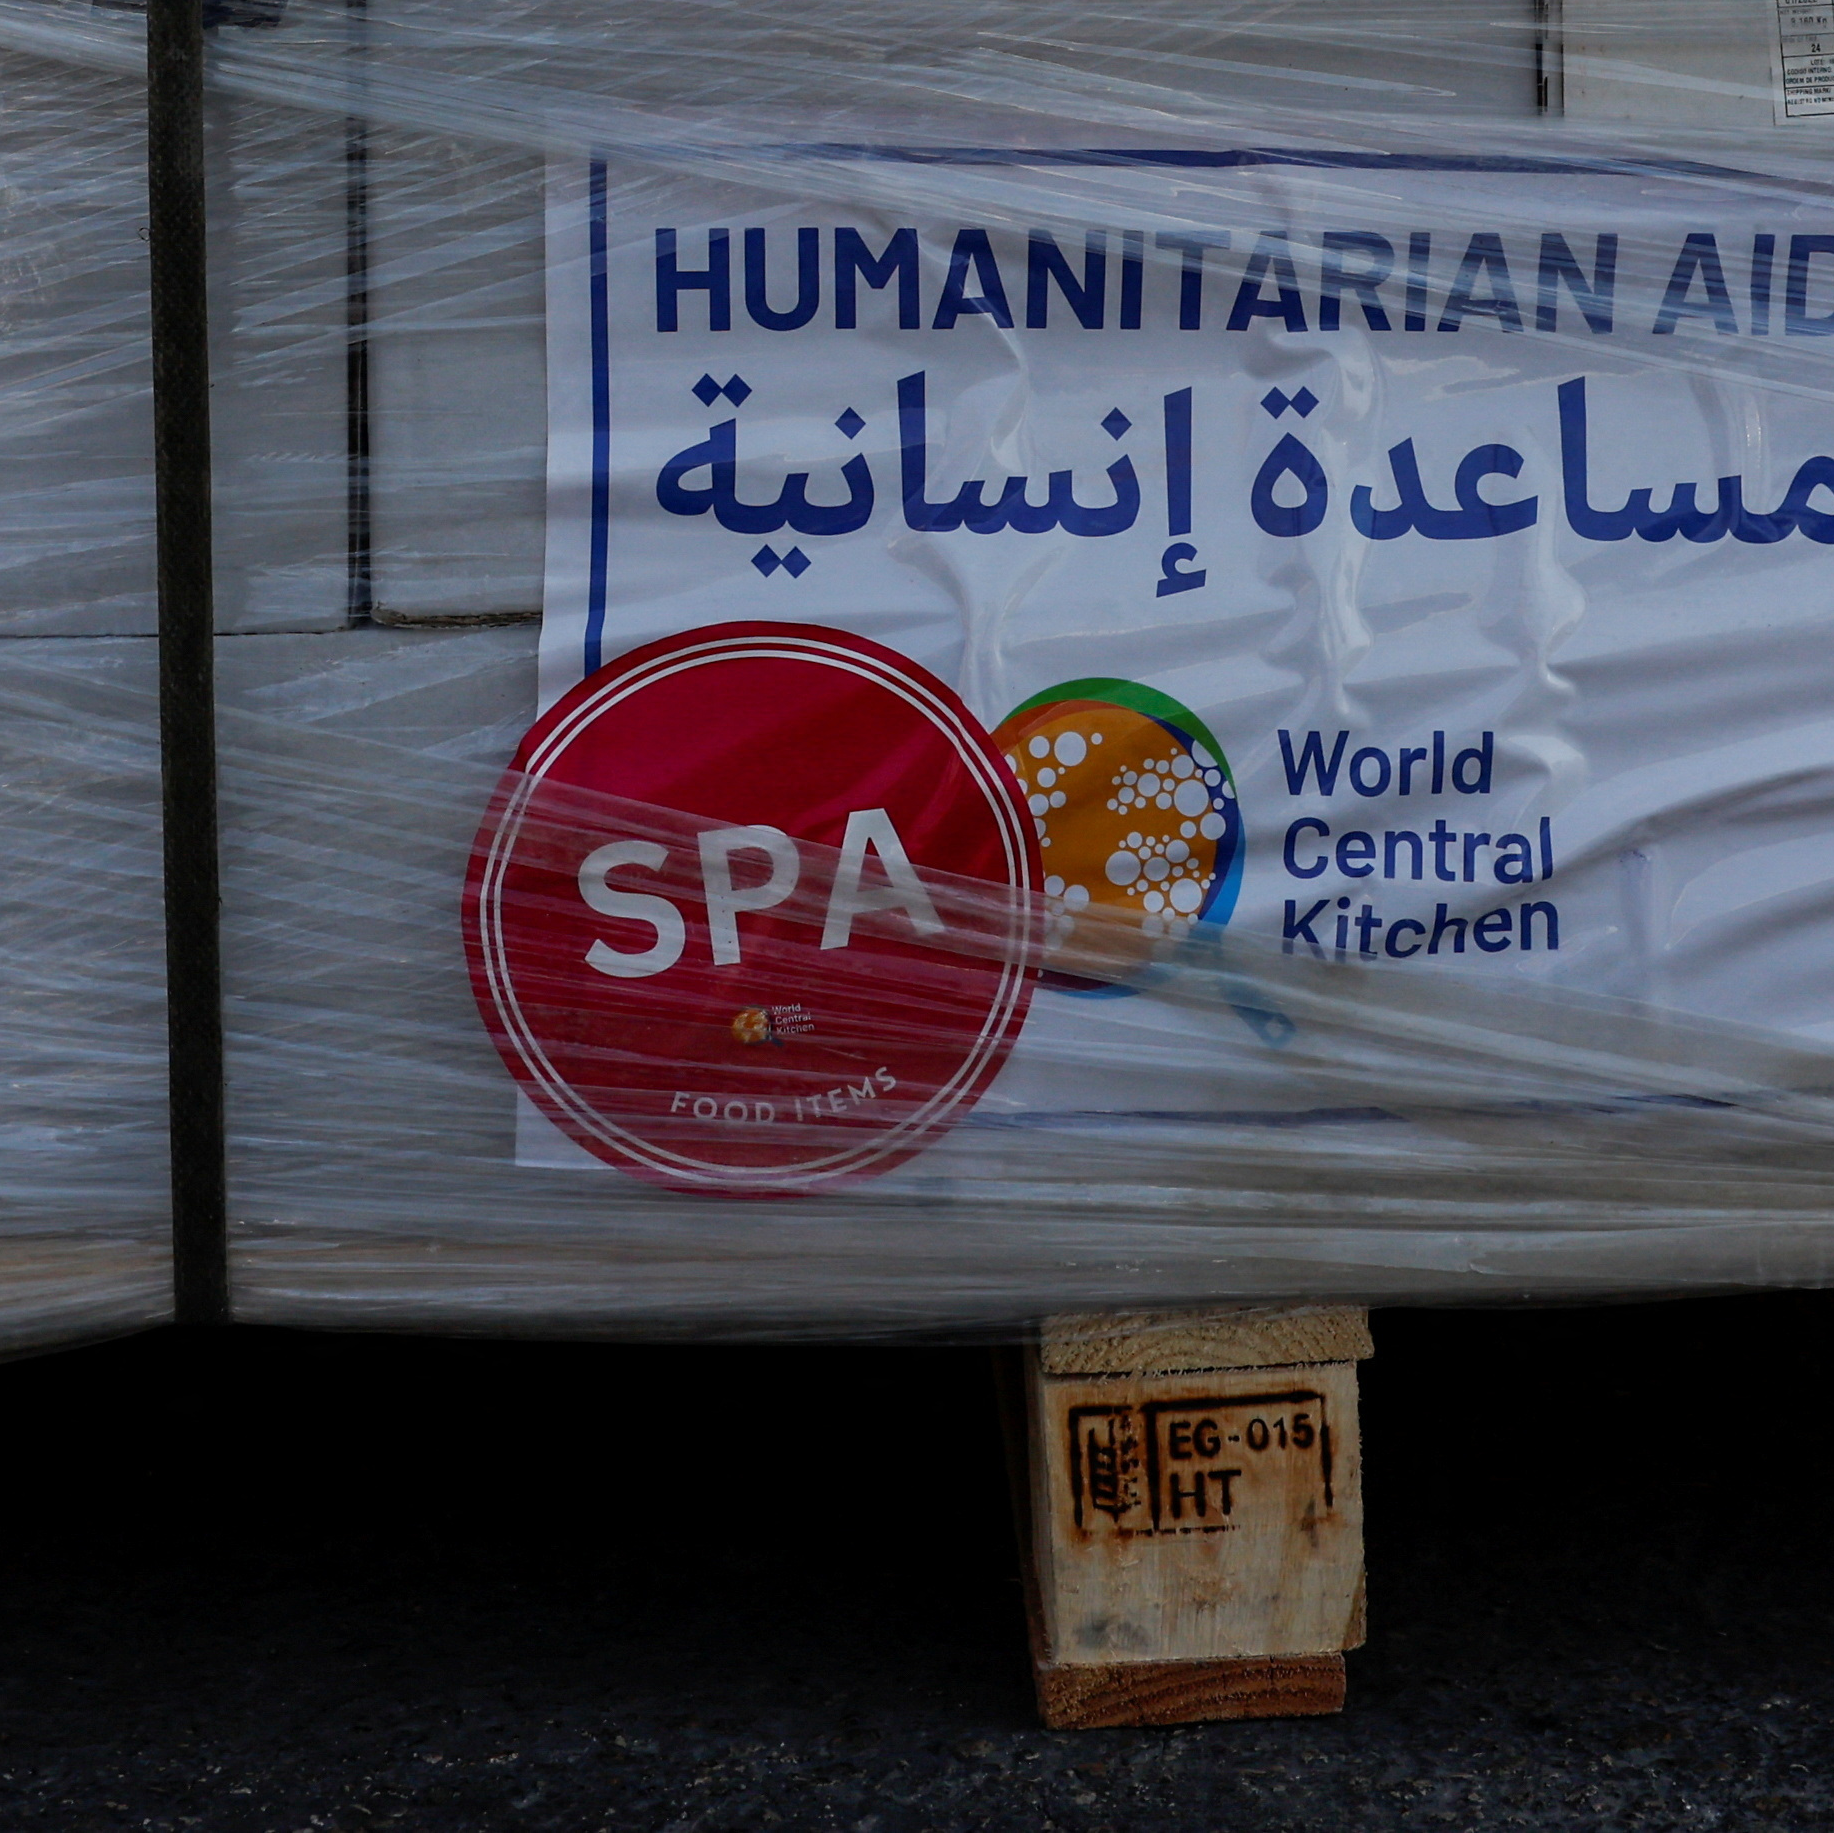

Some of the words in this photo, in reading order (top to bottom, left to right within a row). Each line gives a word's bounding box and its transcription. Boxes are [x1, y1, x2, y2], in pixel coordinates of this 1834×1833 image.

[1811, 44, 1821, 53] 24
[655, 225, 1617, 336] HUMANITARIAN
[654, 369, 1208, 600] إنسانية
[1277, 729, 1494, 798] World
[1283, 816, 1556, 885] Central
[577, 807, 946, 979] SPA
[1282, 896, 1560, 962] Kitchen
[771, 1003, 801, 1015] World
[775, 1012, 812, 1025] Central
[776, 1023, 815, 1035] Kitchen
[670, 1091, 775, 1124] FOOD
[794, 1066, 897, 1122] ITEMS
[1168, 1413, 1315, 1460] EG-015
[1170, 1469, 1242, 1518] HT
